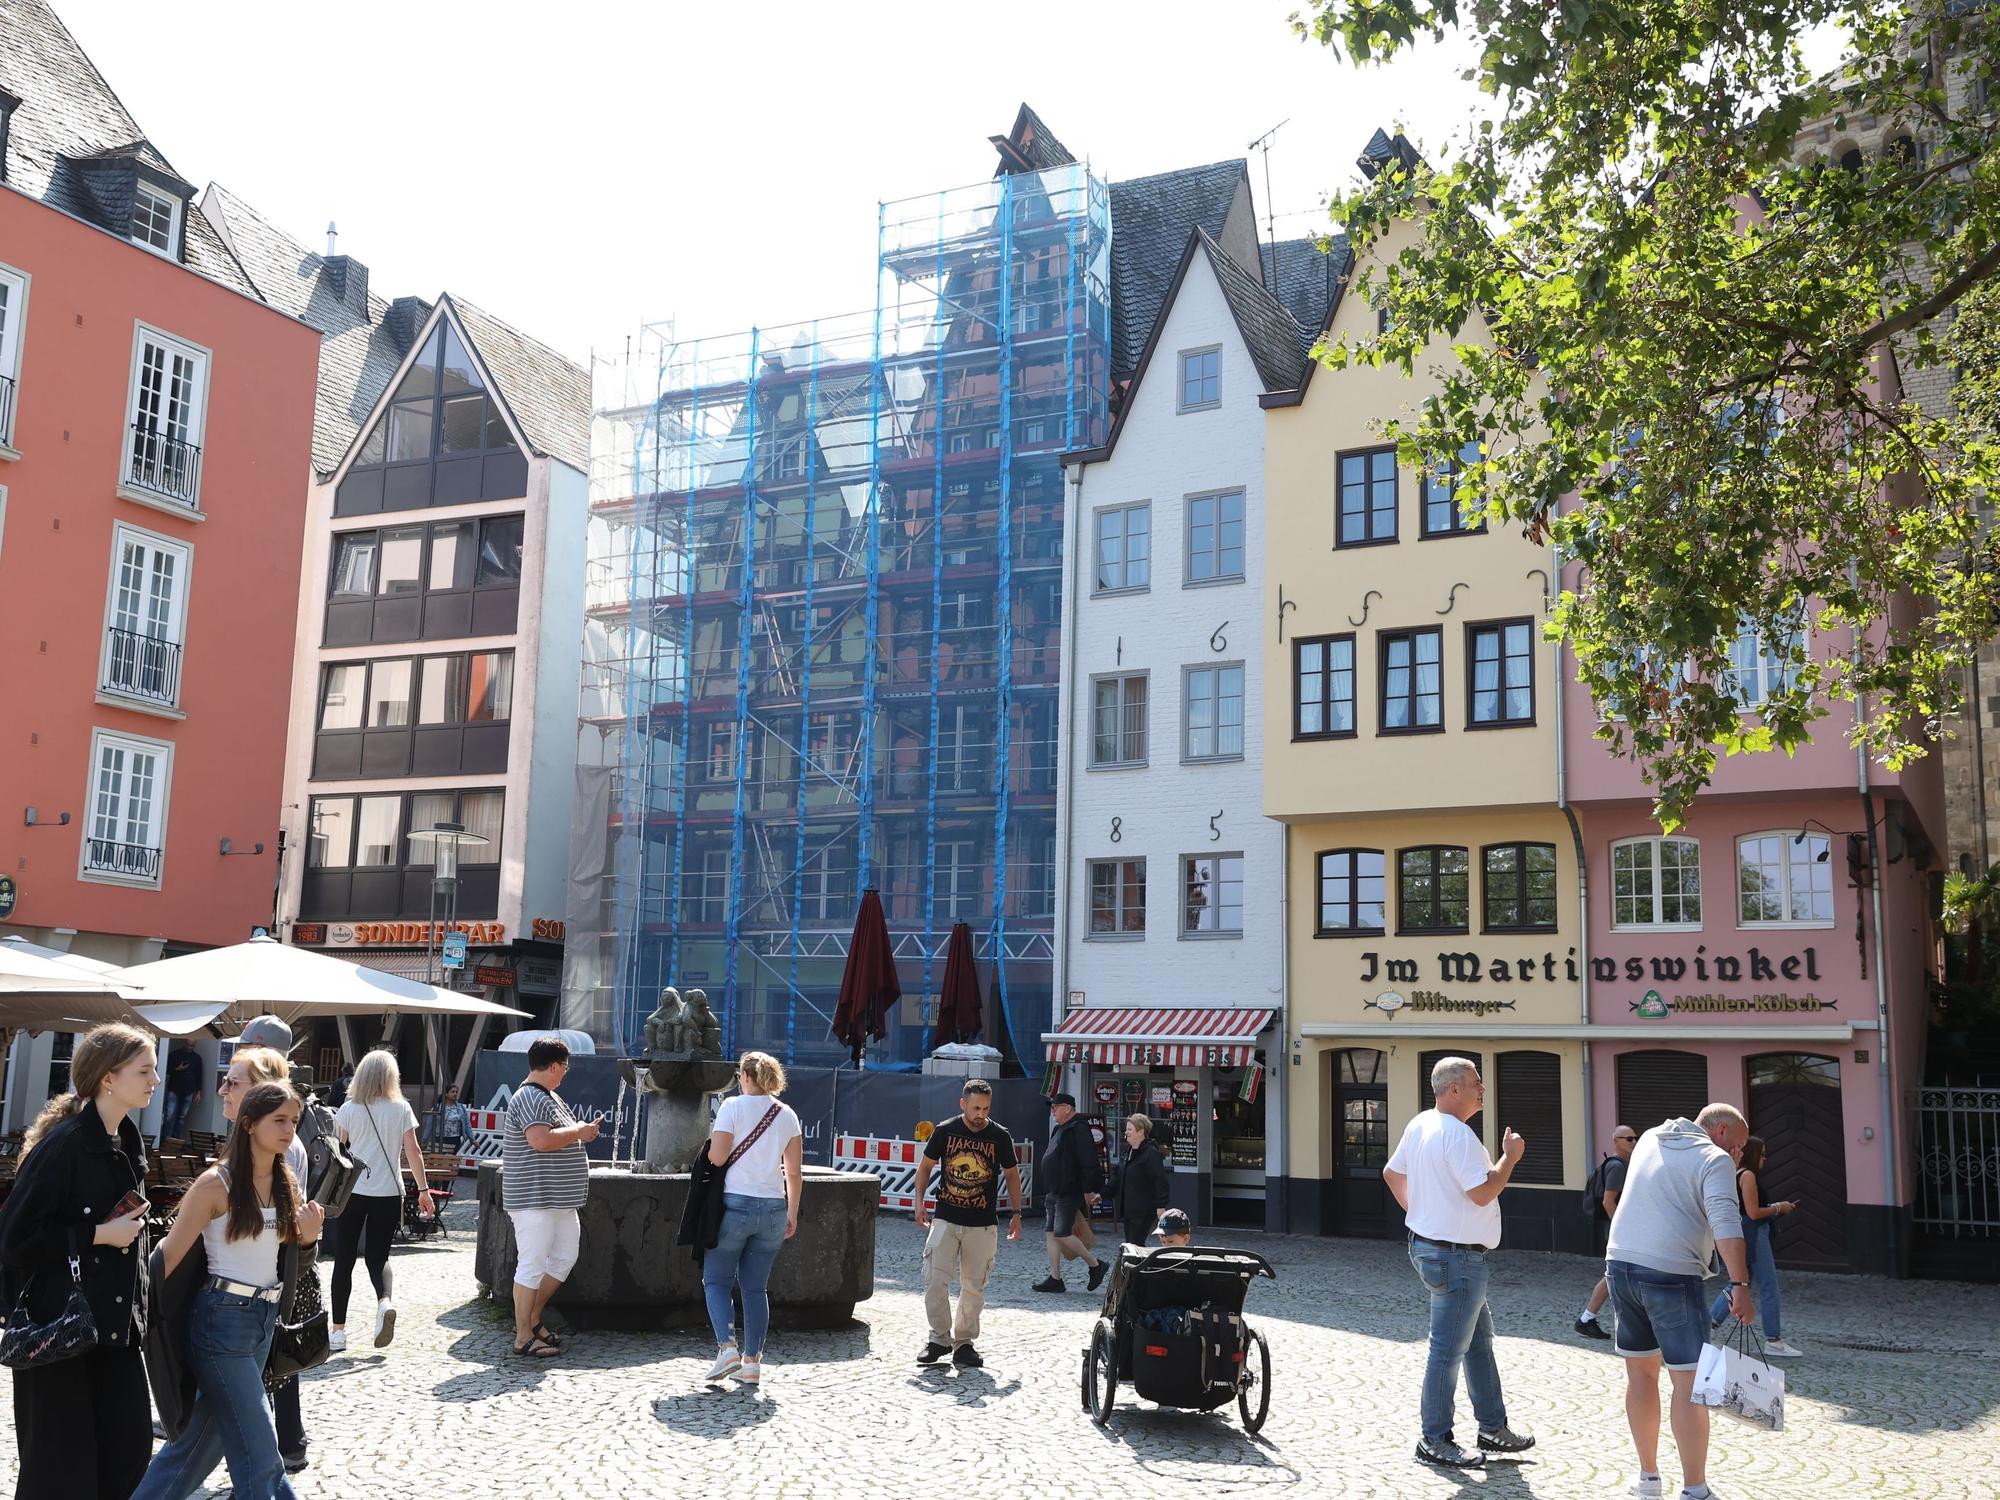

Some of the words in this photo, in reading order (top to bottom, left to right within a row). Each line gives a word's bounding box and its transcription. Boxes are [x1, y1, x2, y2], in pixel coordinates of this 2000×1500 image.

[1109, 816, 1123, 843] 8
[1437, 945, 1822, 983] Martinswinkel
[478, 974, 513, 985] TRINKEN
[1410, 990, 1502, 1017] Bitburger
[1673, 994, 1749, 1013] Mühlen
[1753, 993, 1822, 1012] Kölsch
[946, 1135, 996, 1164] HAKUNA
